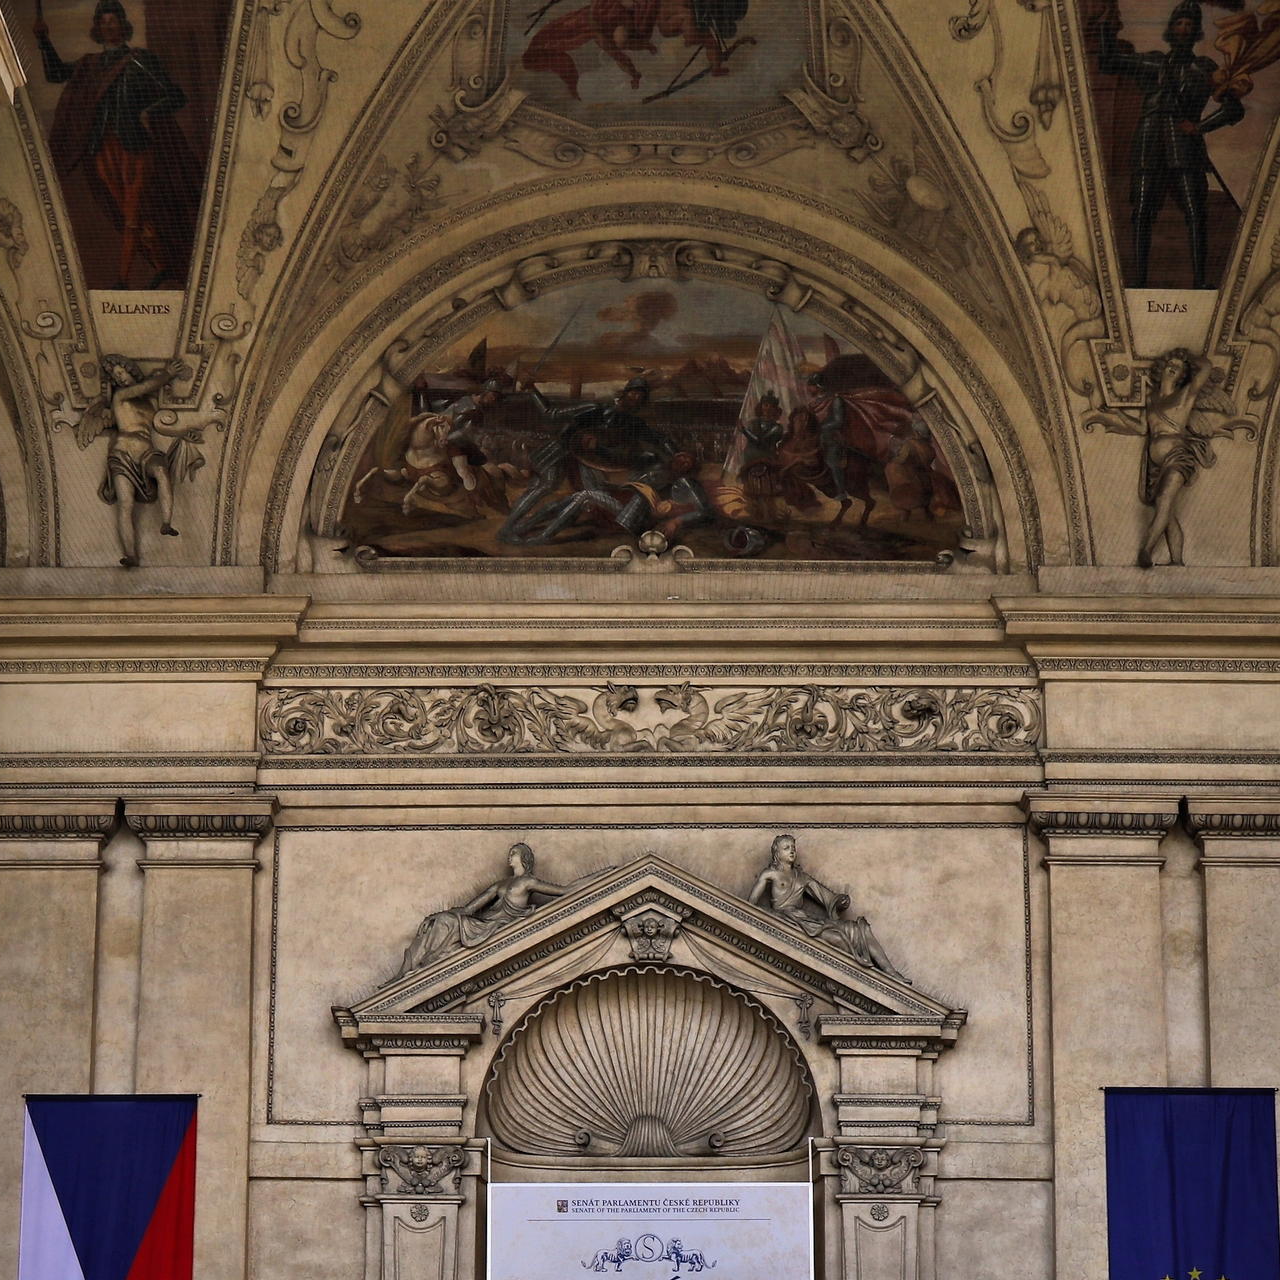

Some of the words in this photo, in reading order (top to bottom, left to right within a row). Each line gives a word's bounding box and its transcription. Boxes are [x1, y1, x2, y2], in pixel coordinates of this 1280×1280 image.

[102, 302, 171, 315] PALLANTES
[1146, 300, 1188, 313] ENEAS
[571, 1199, 599, 1207] SENÁT
[602, 1199, 661, 1207] PARLAMENTU
[663, 1198, 691, 1207] ČESKÉ
[692, 1199, 740, 1207] REPUBLIKY
